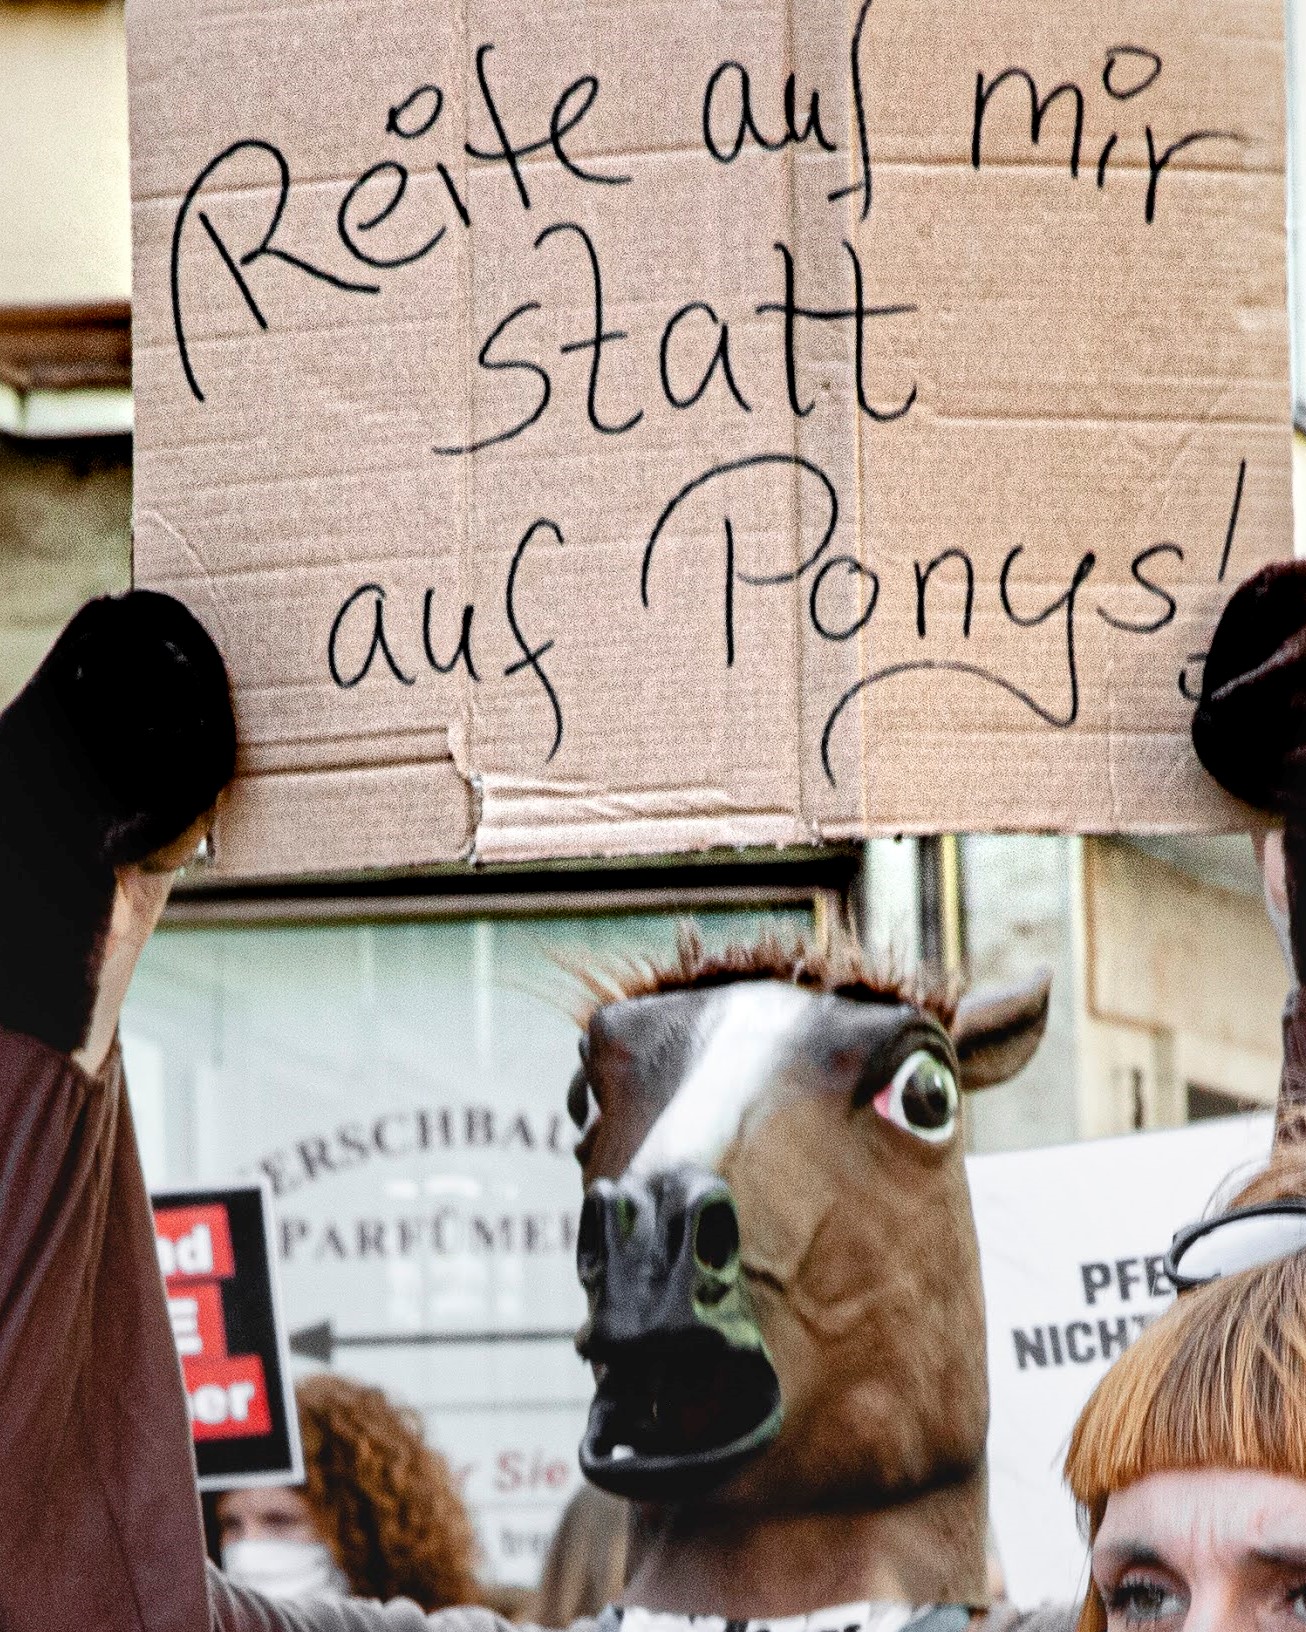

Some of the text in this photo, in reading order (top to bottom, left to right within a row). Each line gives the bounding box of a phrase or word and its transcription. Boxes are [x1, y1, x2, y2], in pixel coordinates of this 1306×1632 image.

[704, 0, 872, 220] auf
[972, 46, 1250, 224] mir
[432, 223, 917, 454] statt
[329, 519, 564, 762] auf
